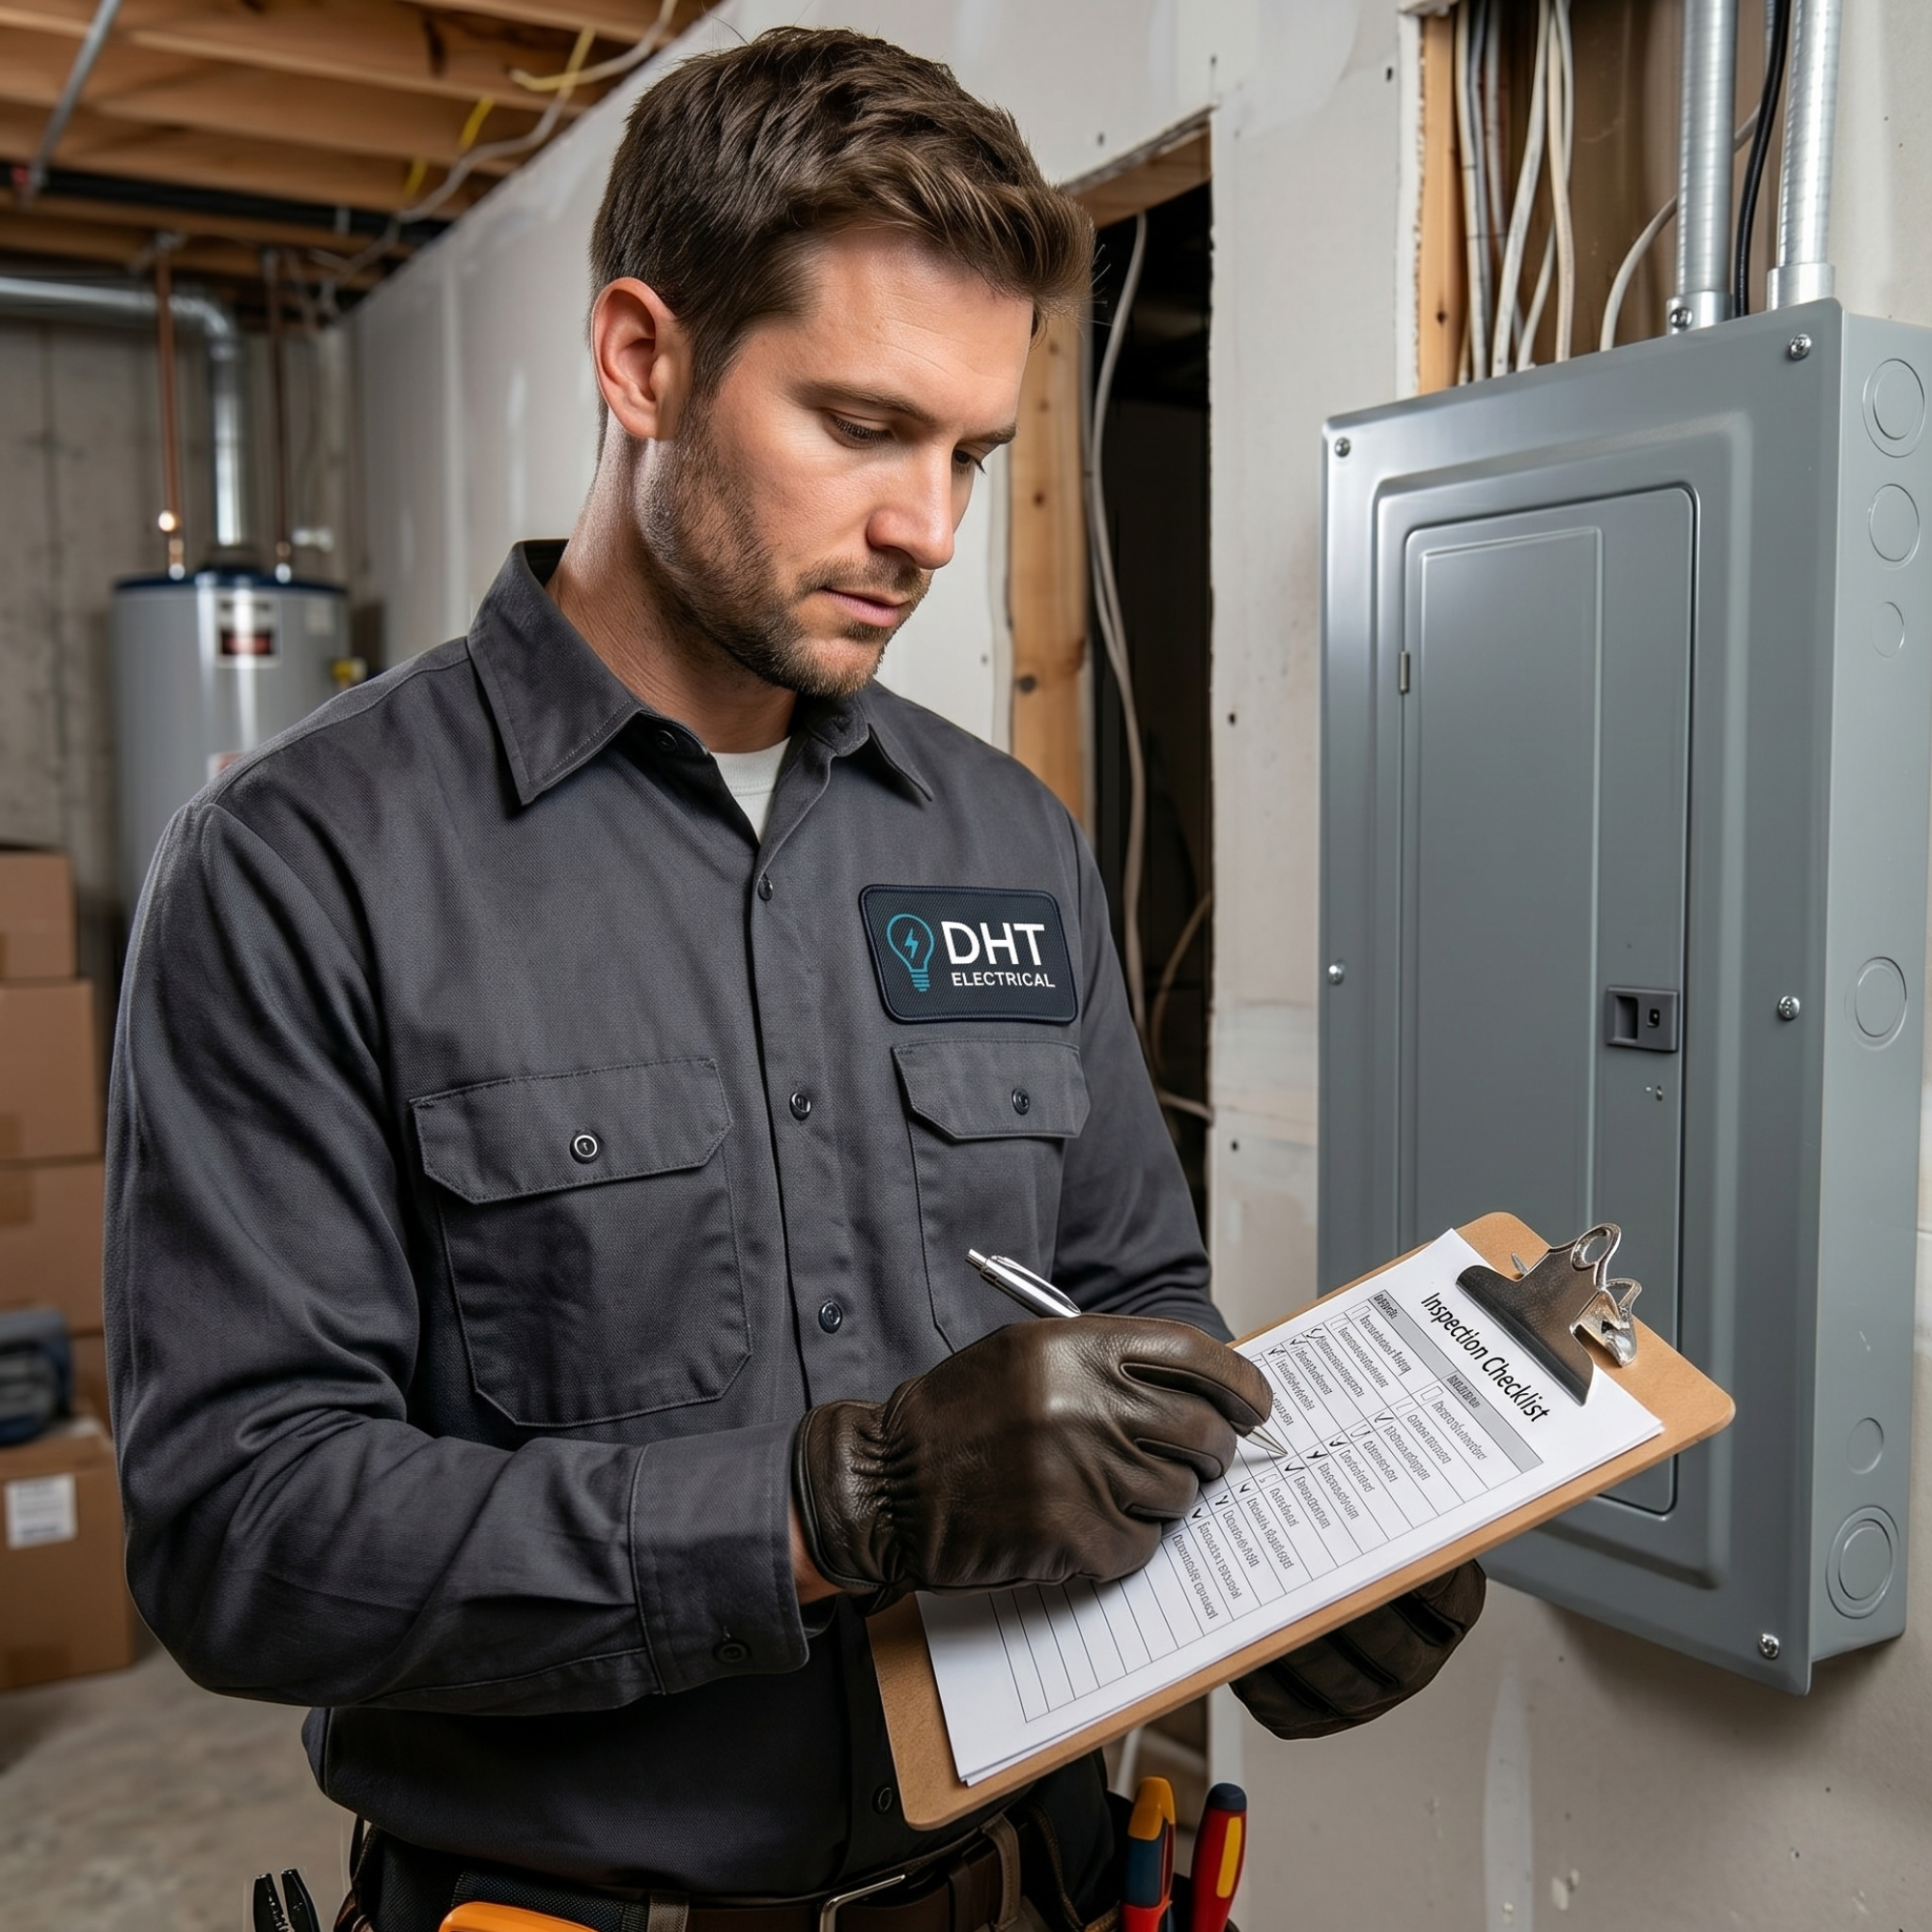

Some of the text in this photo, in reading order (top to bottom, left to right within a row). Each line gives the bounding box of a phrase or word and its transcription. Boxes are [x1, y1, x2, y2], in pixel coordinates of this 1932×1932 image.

[941, 921, 1045, 966] DHT
[952, 972, 1056, 988] ELECTRICAL
[1420, 1292, 1489, 1361] Inspection
[1481, 1356, 1550, 1424] Checklist
